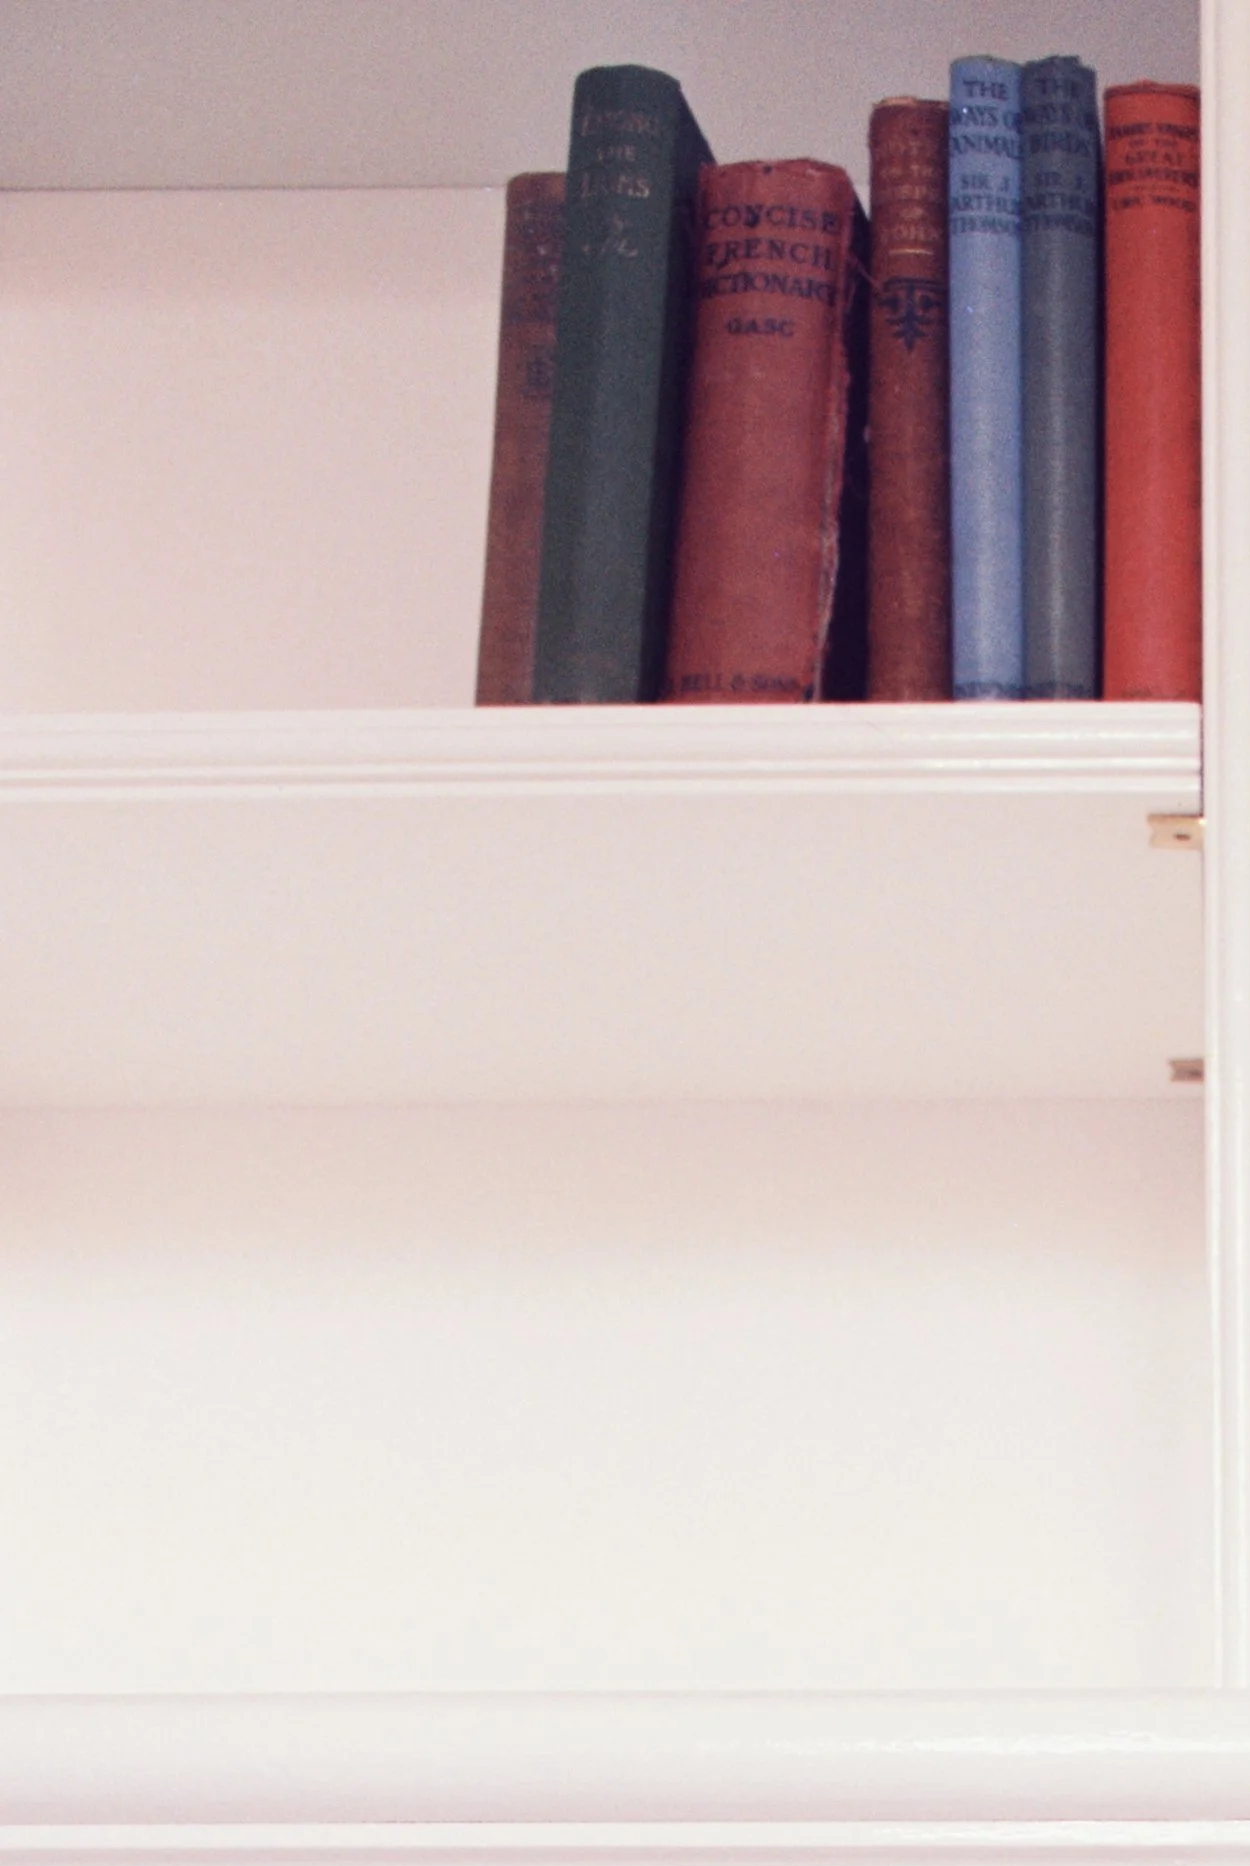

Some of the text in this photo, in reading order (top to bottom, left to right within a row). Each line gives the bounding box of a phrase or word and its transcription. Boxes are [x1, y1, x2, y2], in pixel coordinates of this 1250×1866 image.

[962, 79, 1008, 101] THE
[951, 132, 1021, 160] ANIMAL
[704, 237, 833, 271] FRENCH
